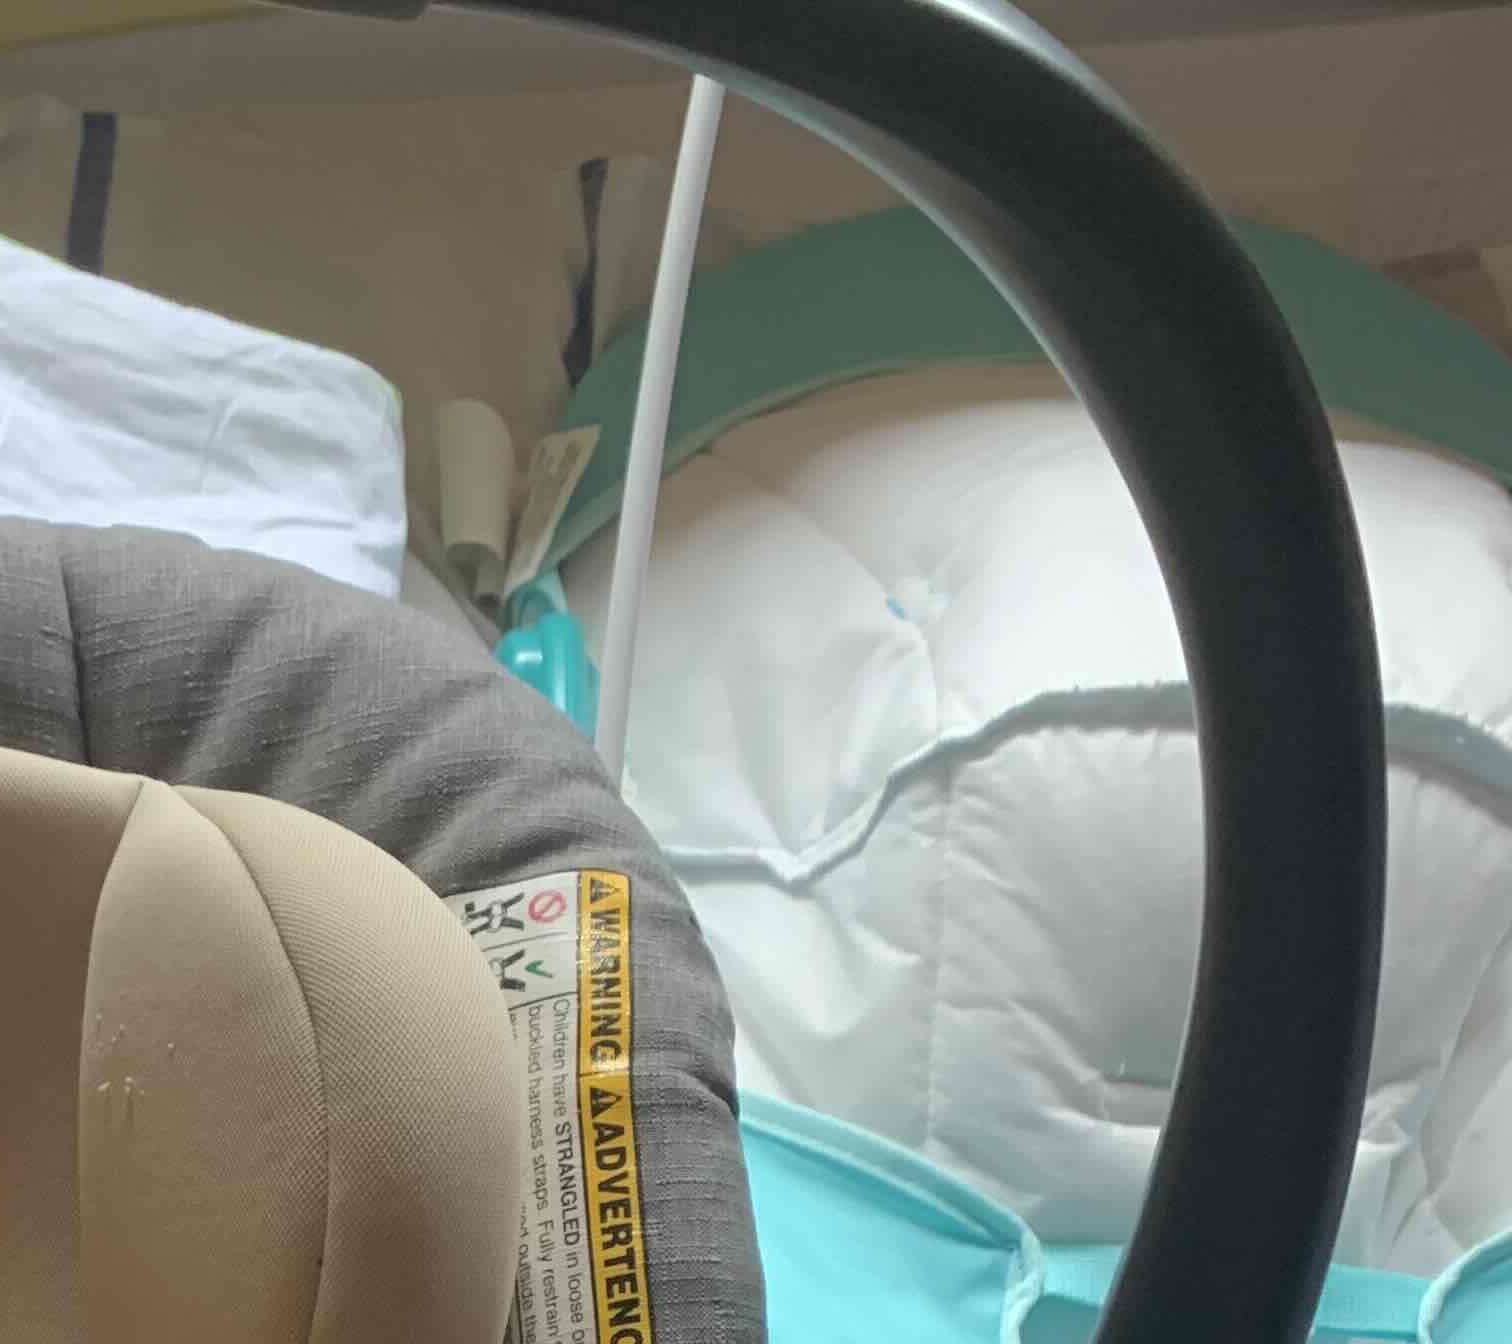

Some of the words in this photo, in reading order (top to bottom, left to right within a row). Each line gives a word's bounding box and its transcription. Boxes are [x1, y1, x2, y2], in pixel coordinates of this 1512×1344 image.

[589, 908, 621, 1063] WARNING
[526, 1005, 543, 1074] buckled
[551, 999, 570, 1071] Children
[526, 1077, 543, 1150] harness
[552, 1074, 568, 1117] have
[553, 1121, 579, 1246] STRANGLED
[536, 1220, 555, 1262] Fully
[565, 1251, 578, 1269] in
[517, 1243, 534, 1312] outside
[541, 1269, 561, 1336] restrain
[566, 1274, 583, 1323] loose
